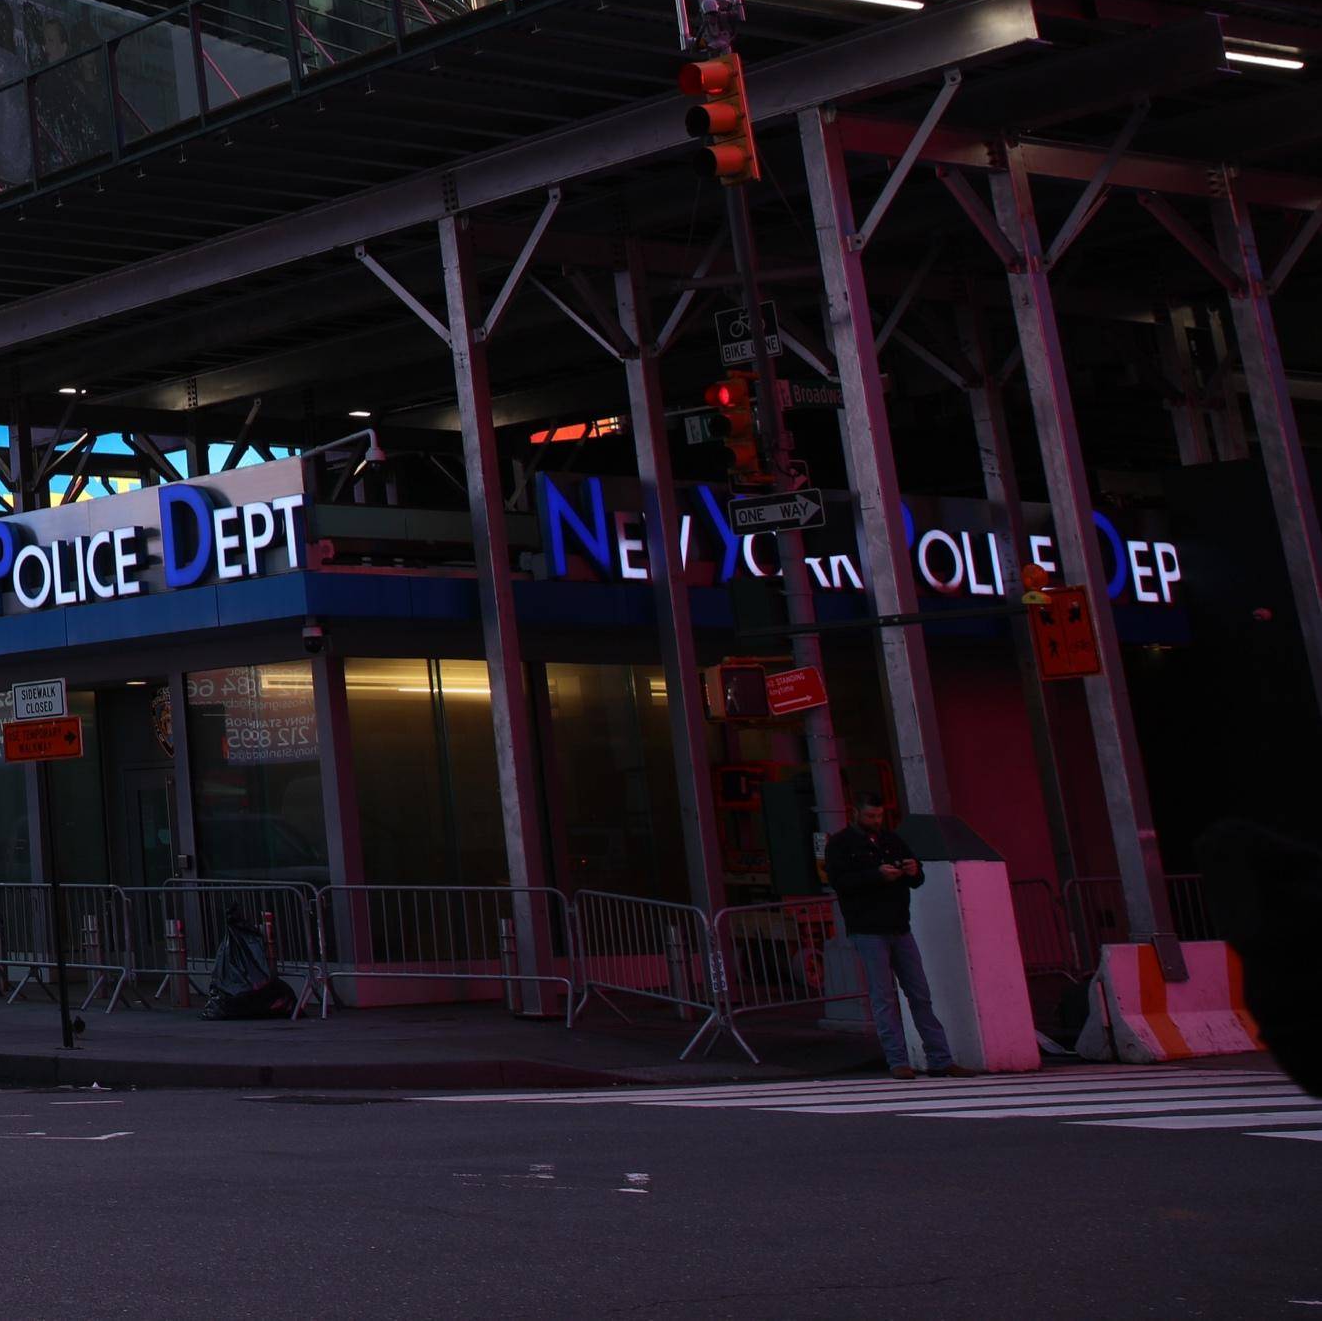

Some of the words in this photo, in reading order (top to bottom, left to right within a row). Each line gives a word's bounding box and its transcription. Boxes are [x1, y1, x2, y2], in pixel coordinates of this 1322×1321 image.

[724, 344, 747, 359] BIKE
[739, 508, 765, 524] ONE
[780, 502, 809, 518] WAY
[21, 686, 56, 700] SIDEWALK
[26, 700, 53, 714] CLOSED
